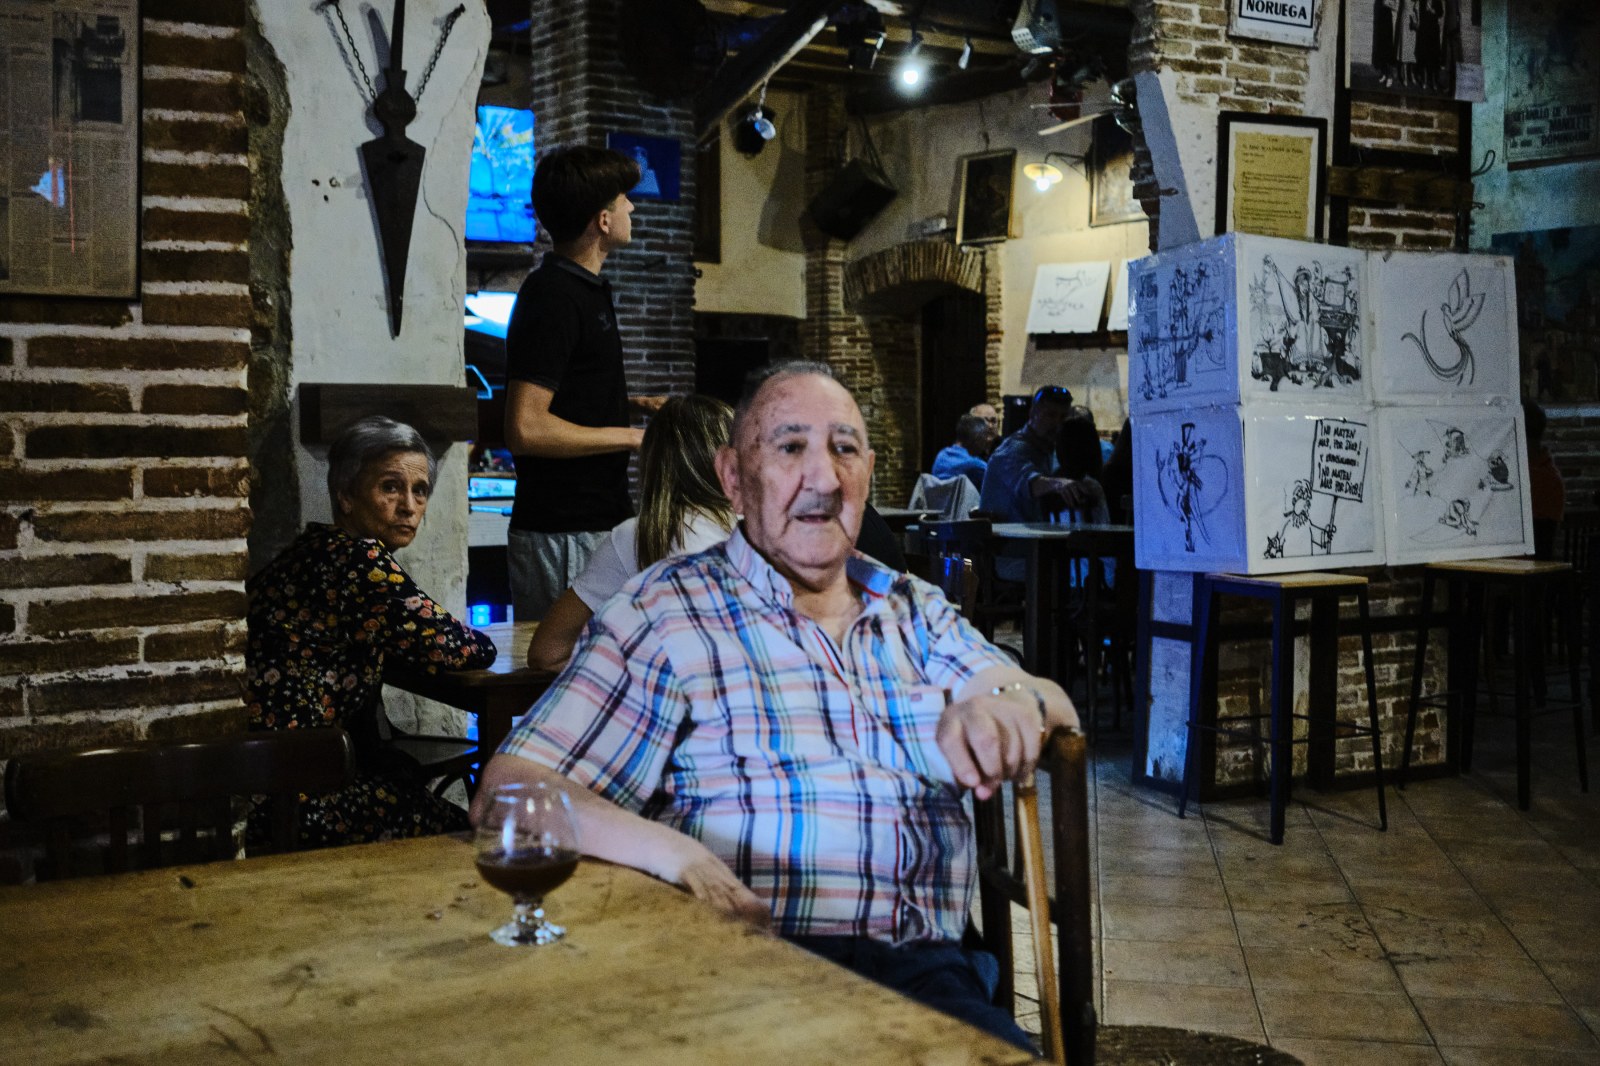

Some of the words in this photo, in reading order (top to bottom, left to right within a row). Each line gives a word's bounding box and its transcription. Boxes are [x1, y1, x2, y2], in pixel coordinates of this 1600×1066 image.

[1246, 0, 1307, 20] NORUEGA
[1333, 426, 1356, 439] MATEN
[1332, 468, 1352, 481] MATEN
